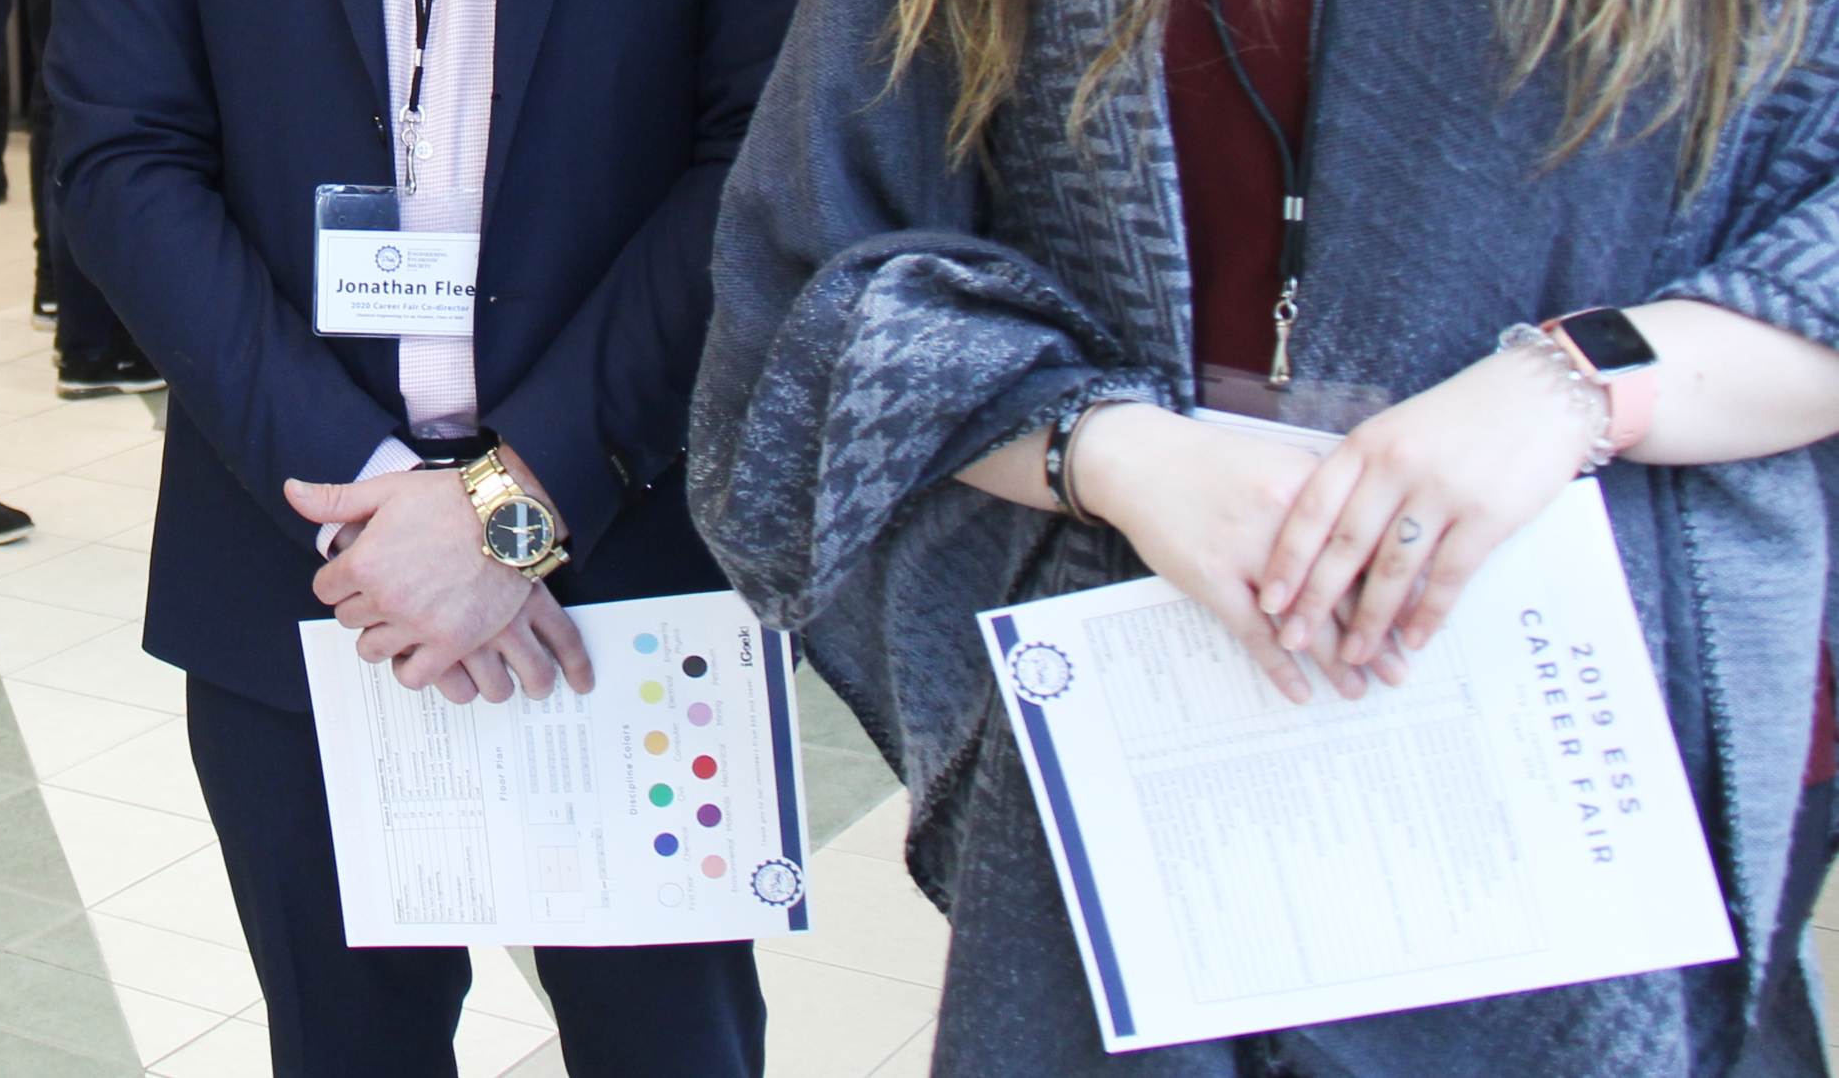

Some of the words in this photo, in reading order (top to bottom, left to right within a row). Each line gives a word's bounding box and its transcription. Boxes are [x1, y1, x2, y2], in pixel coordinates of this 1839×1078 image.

[335, 278, 427, 295] Jonathan
[435, 280, 476, 296] Flee
[373, 302, 401, 311] Career
[403, 302, 419, 311] Fair
[621, 724, 635, 759] Colors
[1520, 609, 1583, 756] CAREER
[1571, 777, 1614, 864] FAIR
[1570, 643, 1615, 727] 2019
[1603, 747, 1641, 814] ESS
[494, 746, 504, 770] Plan
[498, 774, 508, 802] Floor
[625, 763, 639, 815] Discipline
